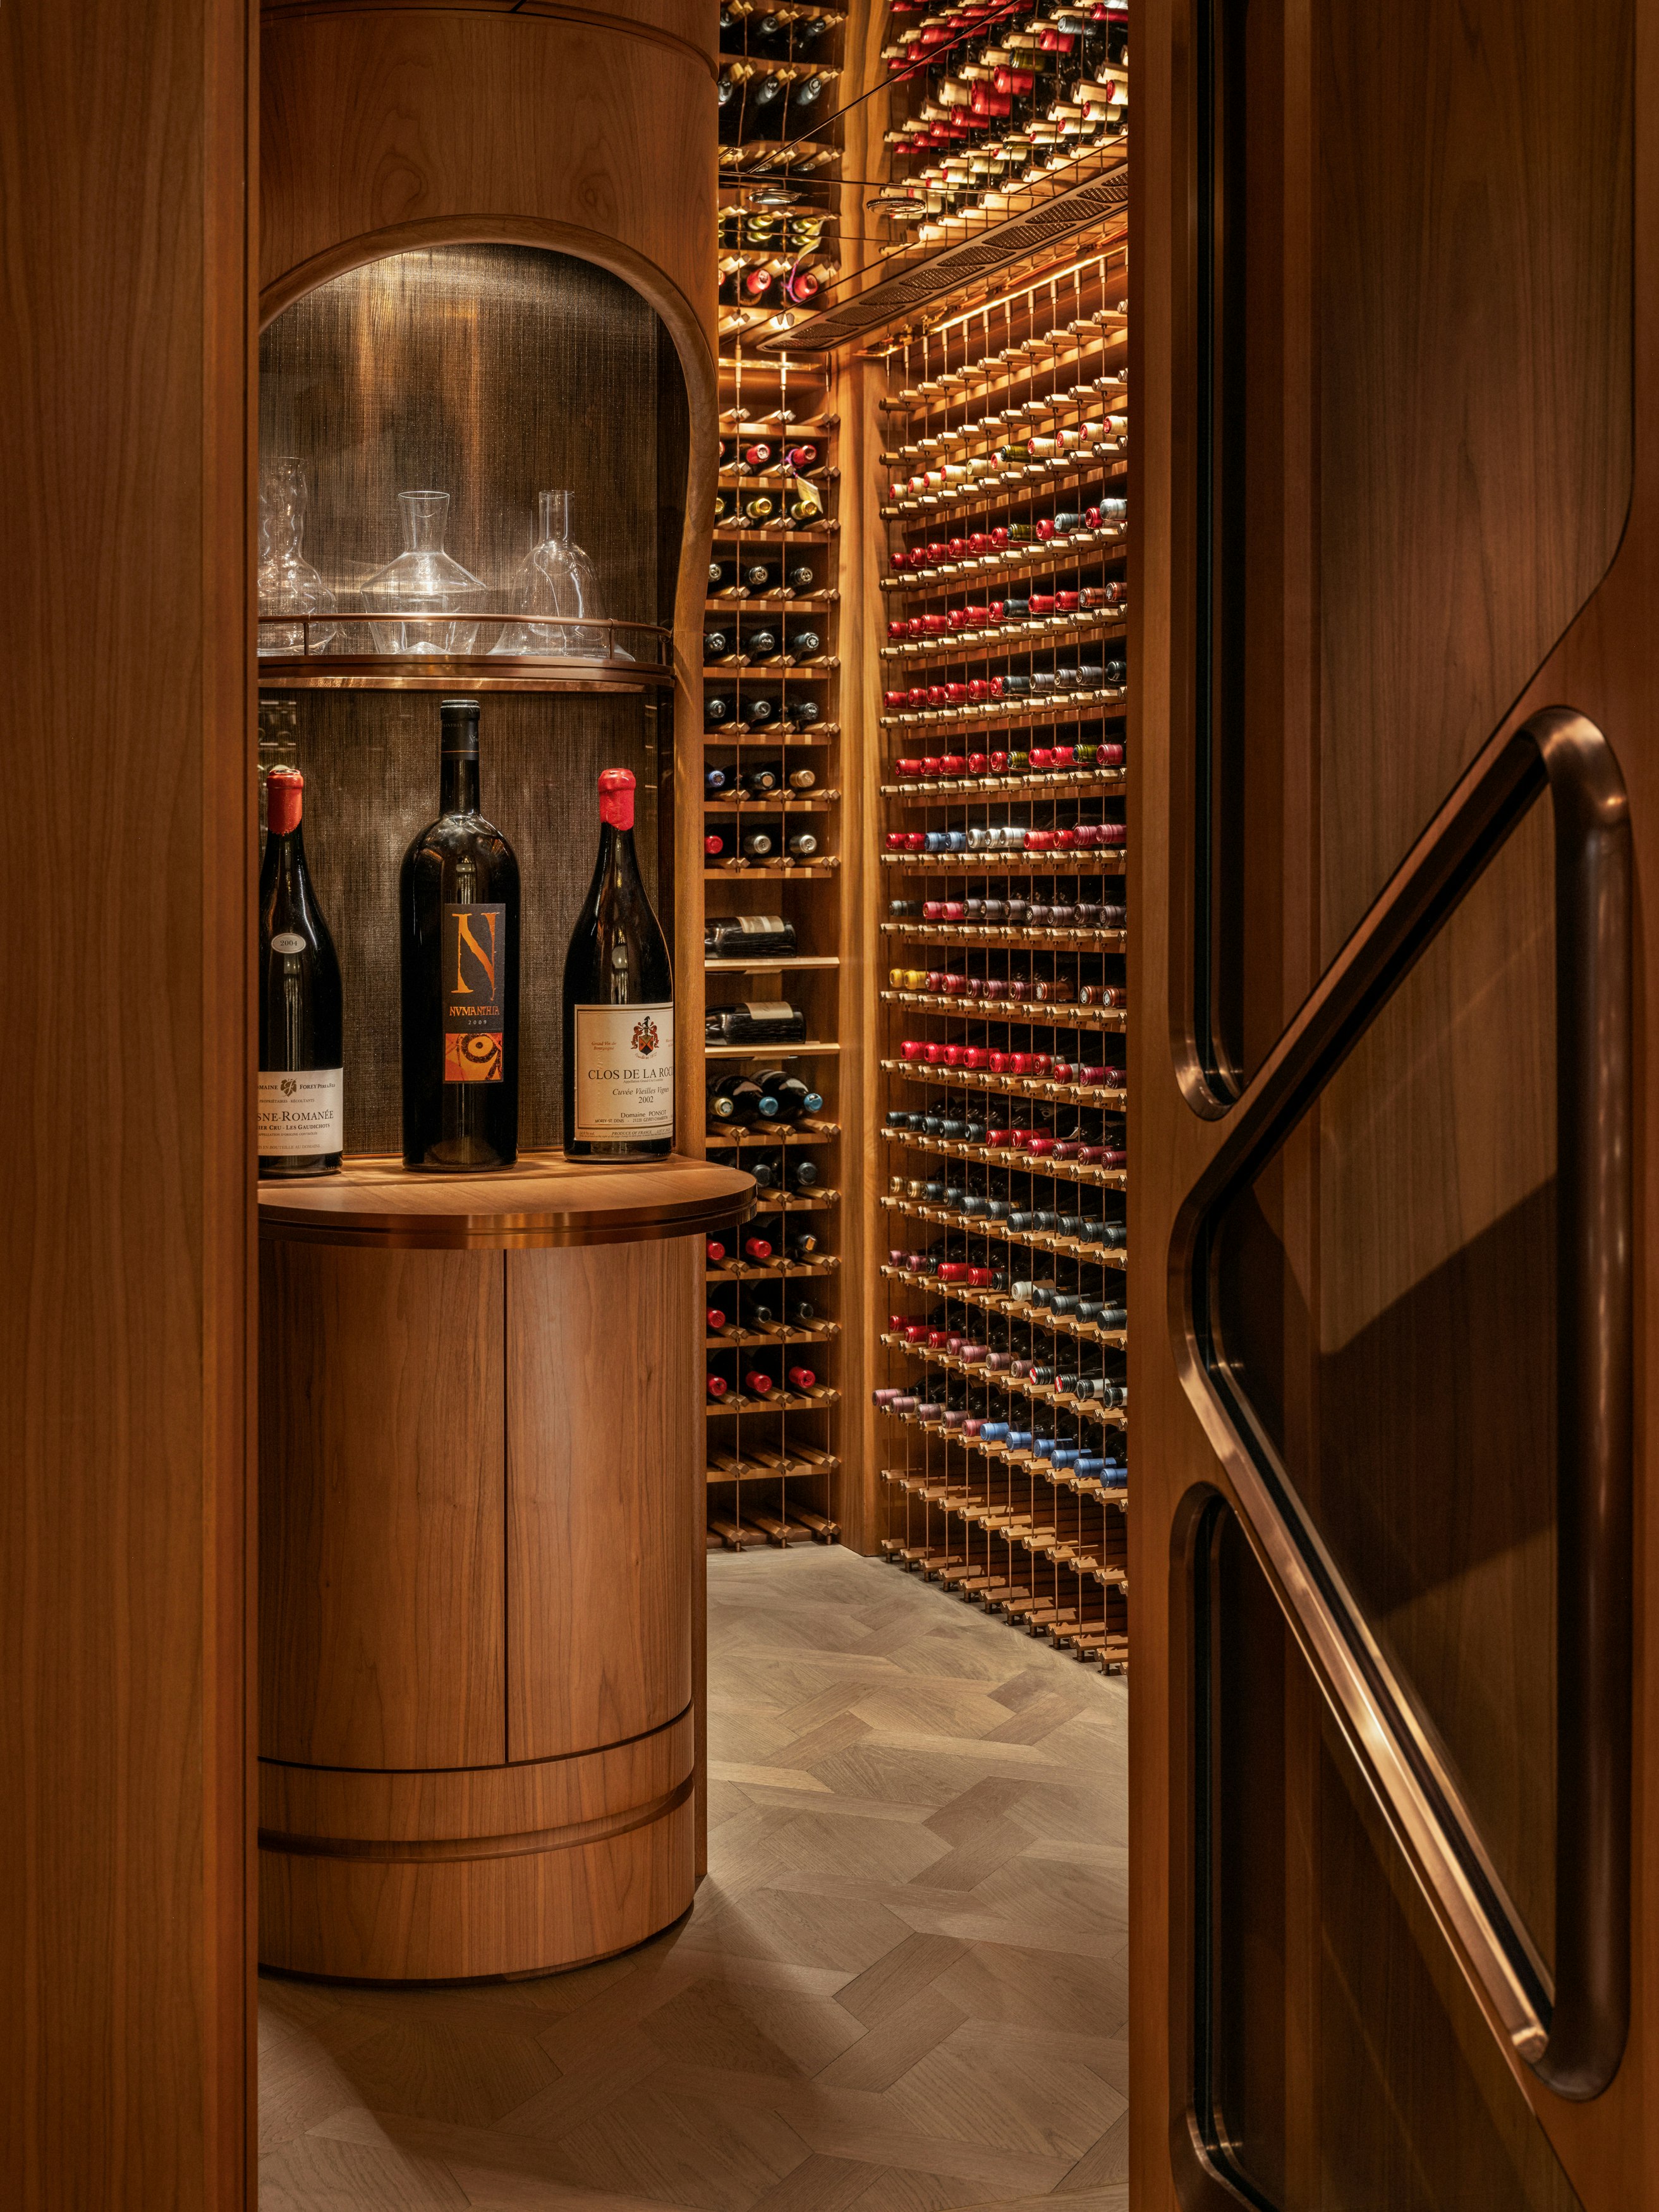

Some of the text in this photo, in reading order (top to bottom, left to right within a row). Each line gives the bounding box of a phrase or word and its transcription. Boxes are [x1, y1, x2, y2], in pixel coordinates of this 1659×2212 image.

[451, 912, 500, 1001] N
[588, 1070, 620, 1079] CLOS
[623, 1069, 640, 1079] DE
[643, 1069, 656, 1079] LA
